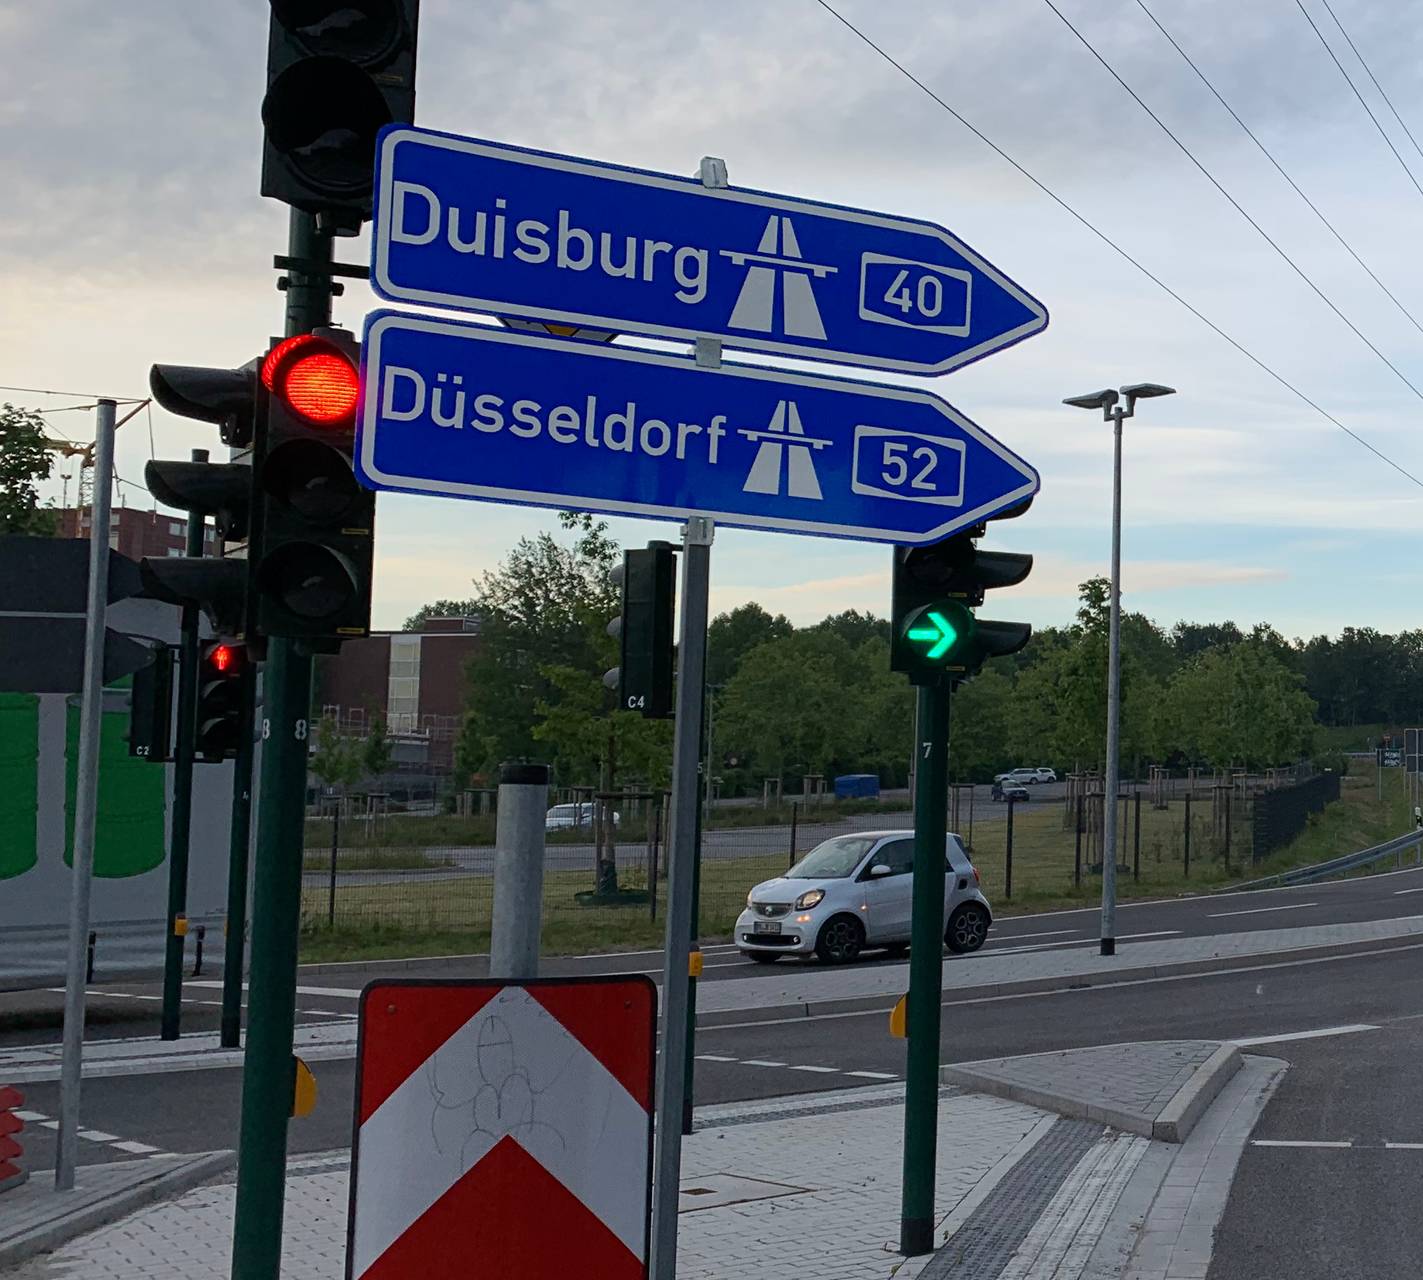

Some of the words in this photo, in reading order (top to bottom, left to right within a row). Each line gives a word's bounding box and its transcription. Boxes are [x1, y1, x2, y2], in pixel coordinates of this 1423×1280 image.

[391, 181, 709, 303] Duisburg
[883, 269, 944, 318] 40
[382, 366, 727, 464] Düsseldorf
[880, 442, 938, 491] 52
[627, 695, 645, 709] C4
[294, 719, 307, 740] 8
[136, 745, 150, 756] C2
[922, 742, 933, 759] 7
